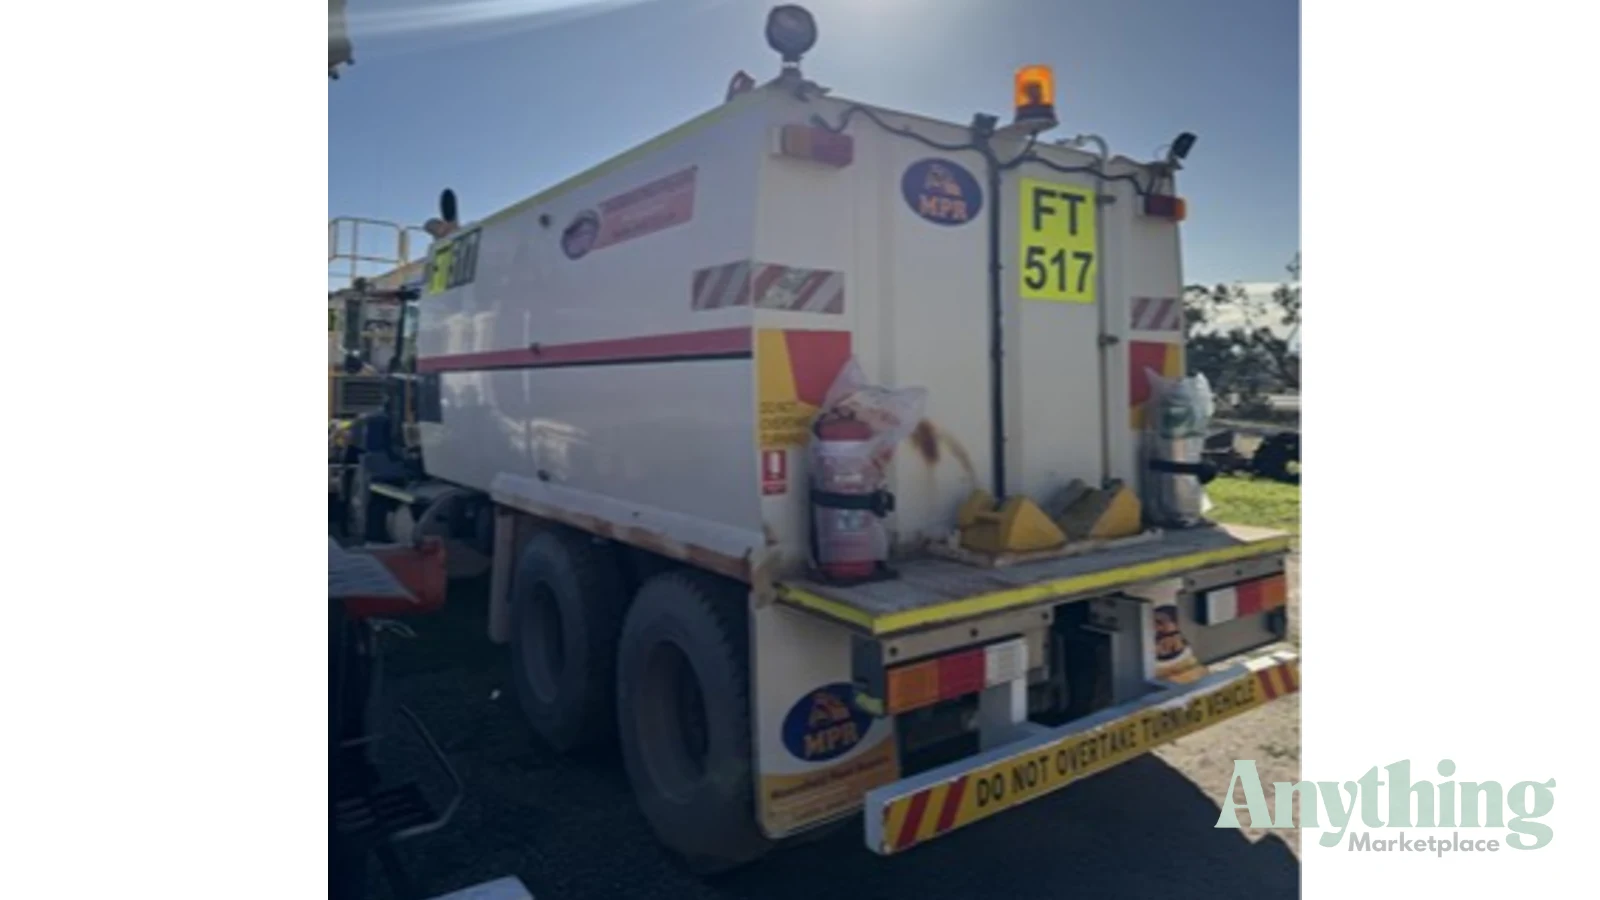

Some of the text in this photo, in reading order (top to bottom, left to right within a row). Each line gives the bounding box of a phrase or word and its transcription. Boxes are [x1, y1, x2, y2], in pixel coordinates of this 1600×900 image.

[919, 193, 968, 221] MPR
[1032, 186, 1087, 237] FT
[1024, 245, 1094, 294] 517
[803, 722, 858, 758] MPR
[975, 680, 1256, 808] DO NOT OVERTAKE TURNING VEHICLE
